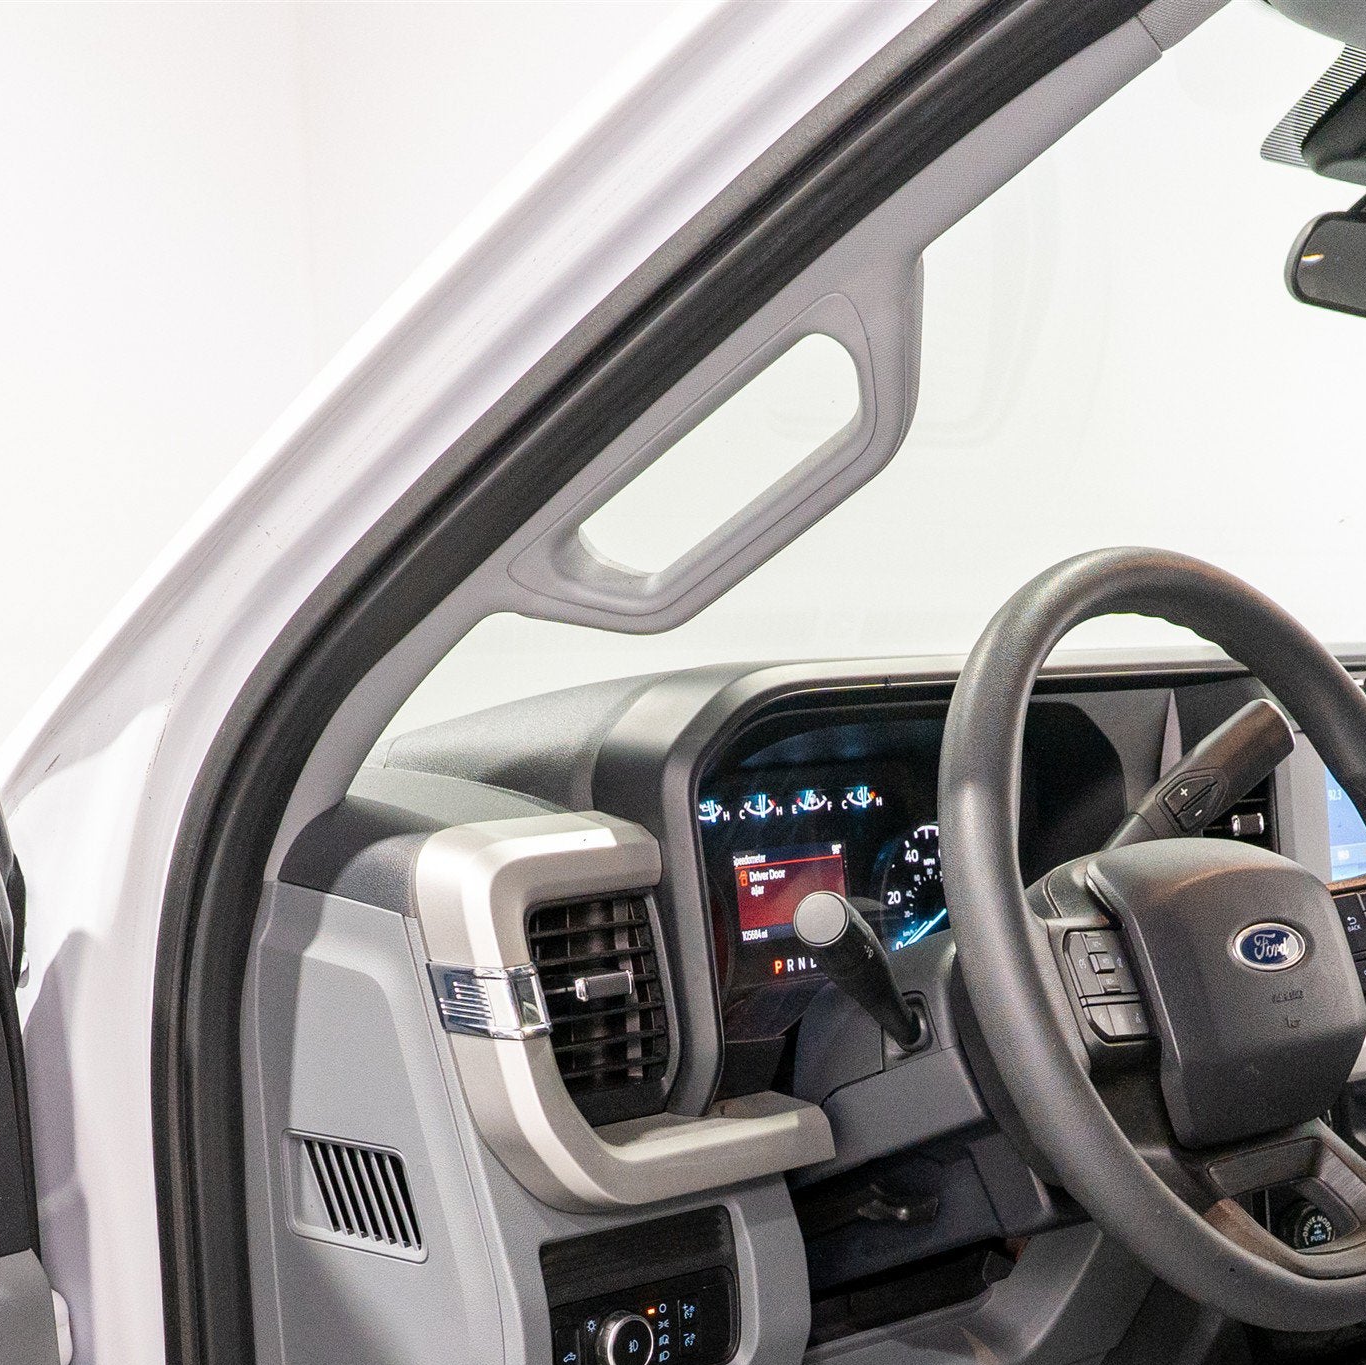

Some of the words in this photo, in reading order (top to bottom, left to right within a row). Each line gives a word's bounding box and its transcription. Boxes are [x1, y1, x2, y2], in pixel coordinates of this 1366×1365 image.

[791, 805, 798, 815] E
[827, 801, 833, 811] F
[841, 802, 848, 810] C
[876, 797, 883, 807] H
[723, 811, 730, 821] H
[739, 811, 745, 820] C
[776, 806, 783, 816] H
[904, 848, 920, 862] 40
[749, 870, 769, 883] Driver
[769, 869, 786, 880] Door
[750, 885, 765, 898] ajar
[887, 890, 902, 905] 20
[1347, 924, 1361, 932] BACK
[1254, 933, 1290, 960] Ford
[774, 960, 783, 975] P
[786, 958, 795, 972] R
[797, 957, 806, 971] N
[1302, 1216, 1317, 1237] DRIVE
[1316, 1215, 1333, 1232] MODE
[1310, 1234, 1326, 1242] PUSH
